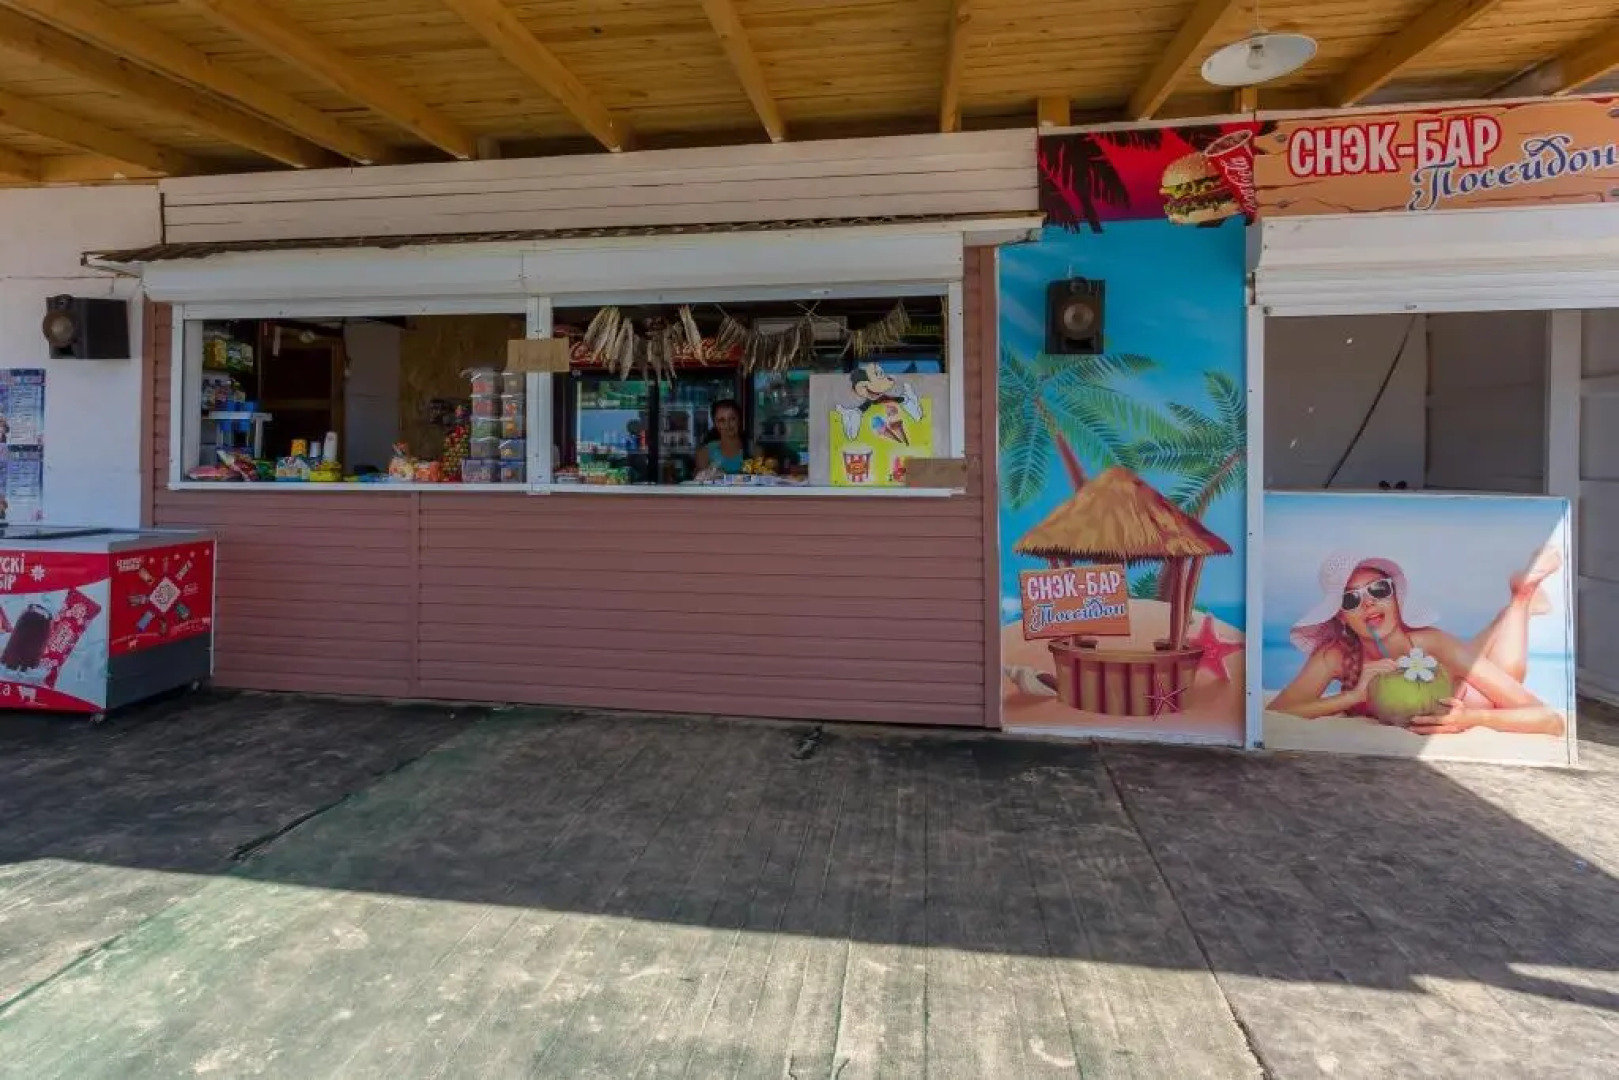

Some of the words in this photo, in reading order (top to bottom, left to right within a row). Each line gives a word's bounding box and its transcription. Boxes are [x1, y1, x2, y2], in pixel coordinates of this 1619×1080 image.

[1289, 115, 1501, 177] СНЭК-БАР
[1409, 133, 1616, 211] Посейдон
[1027, 570, 1120, 600] СНЭК-БАР
